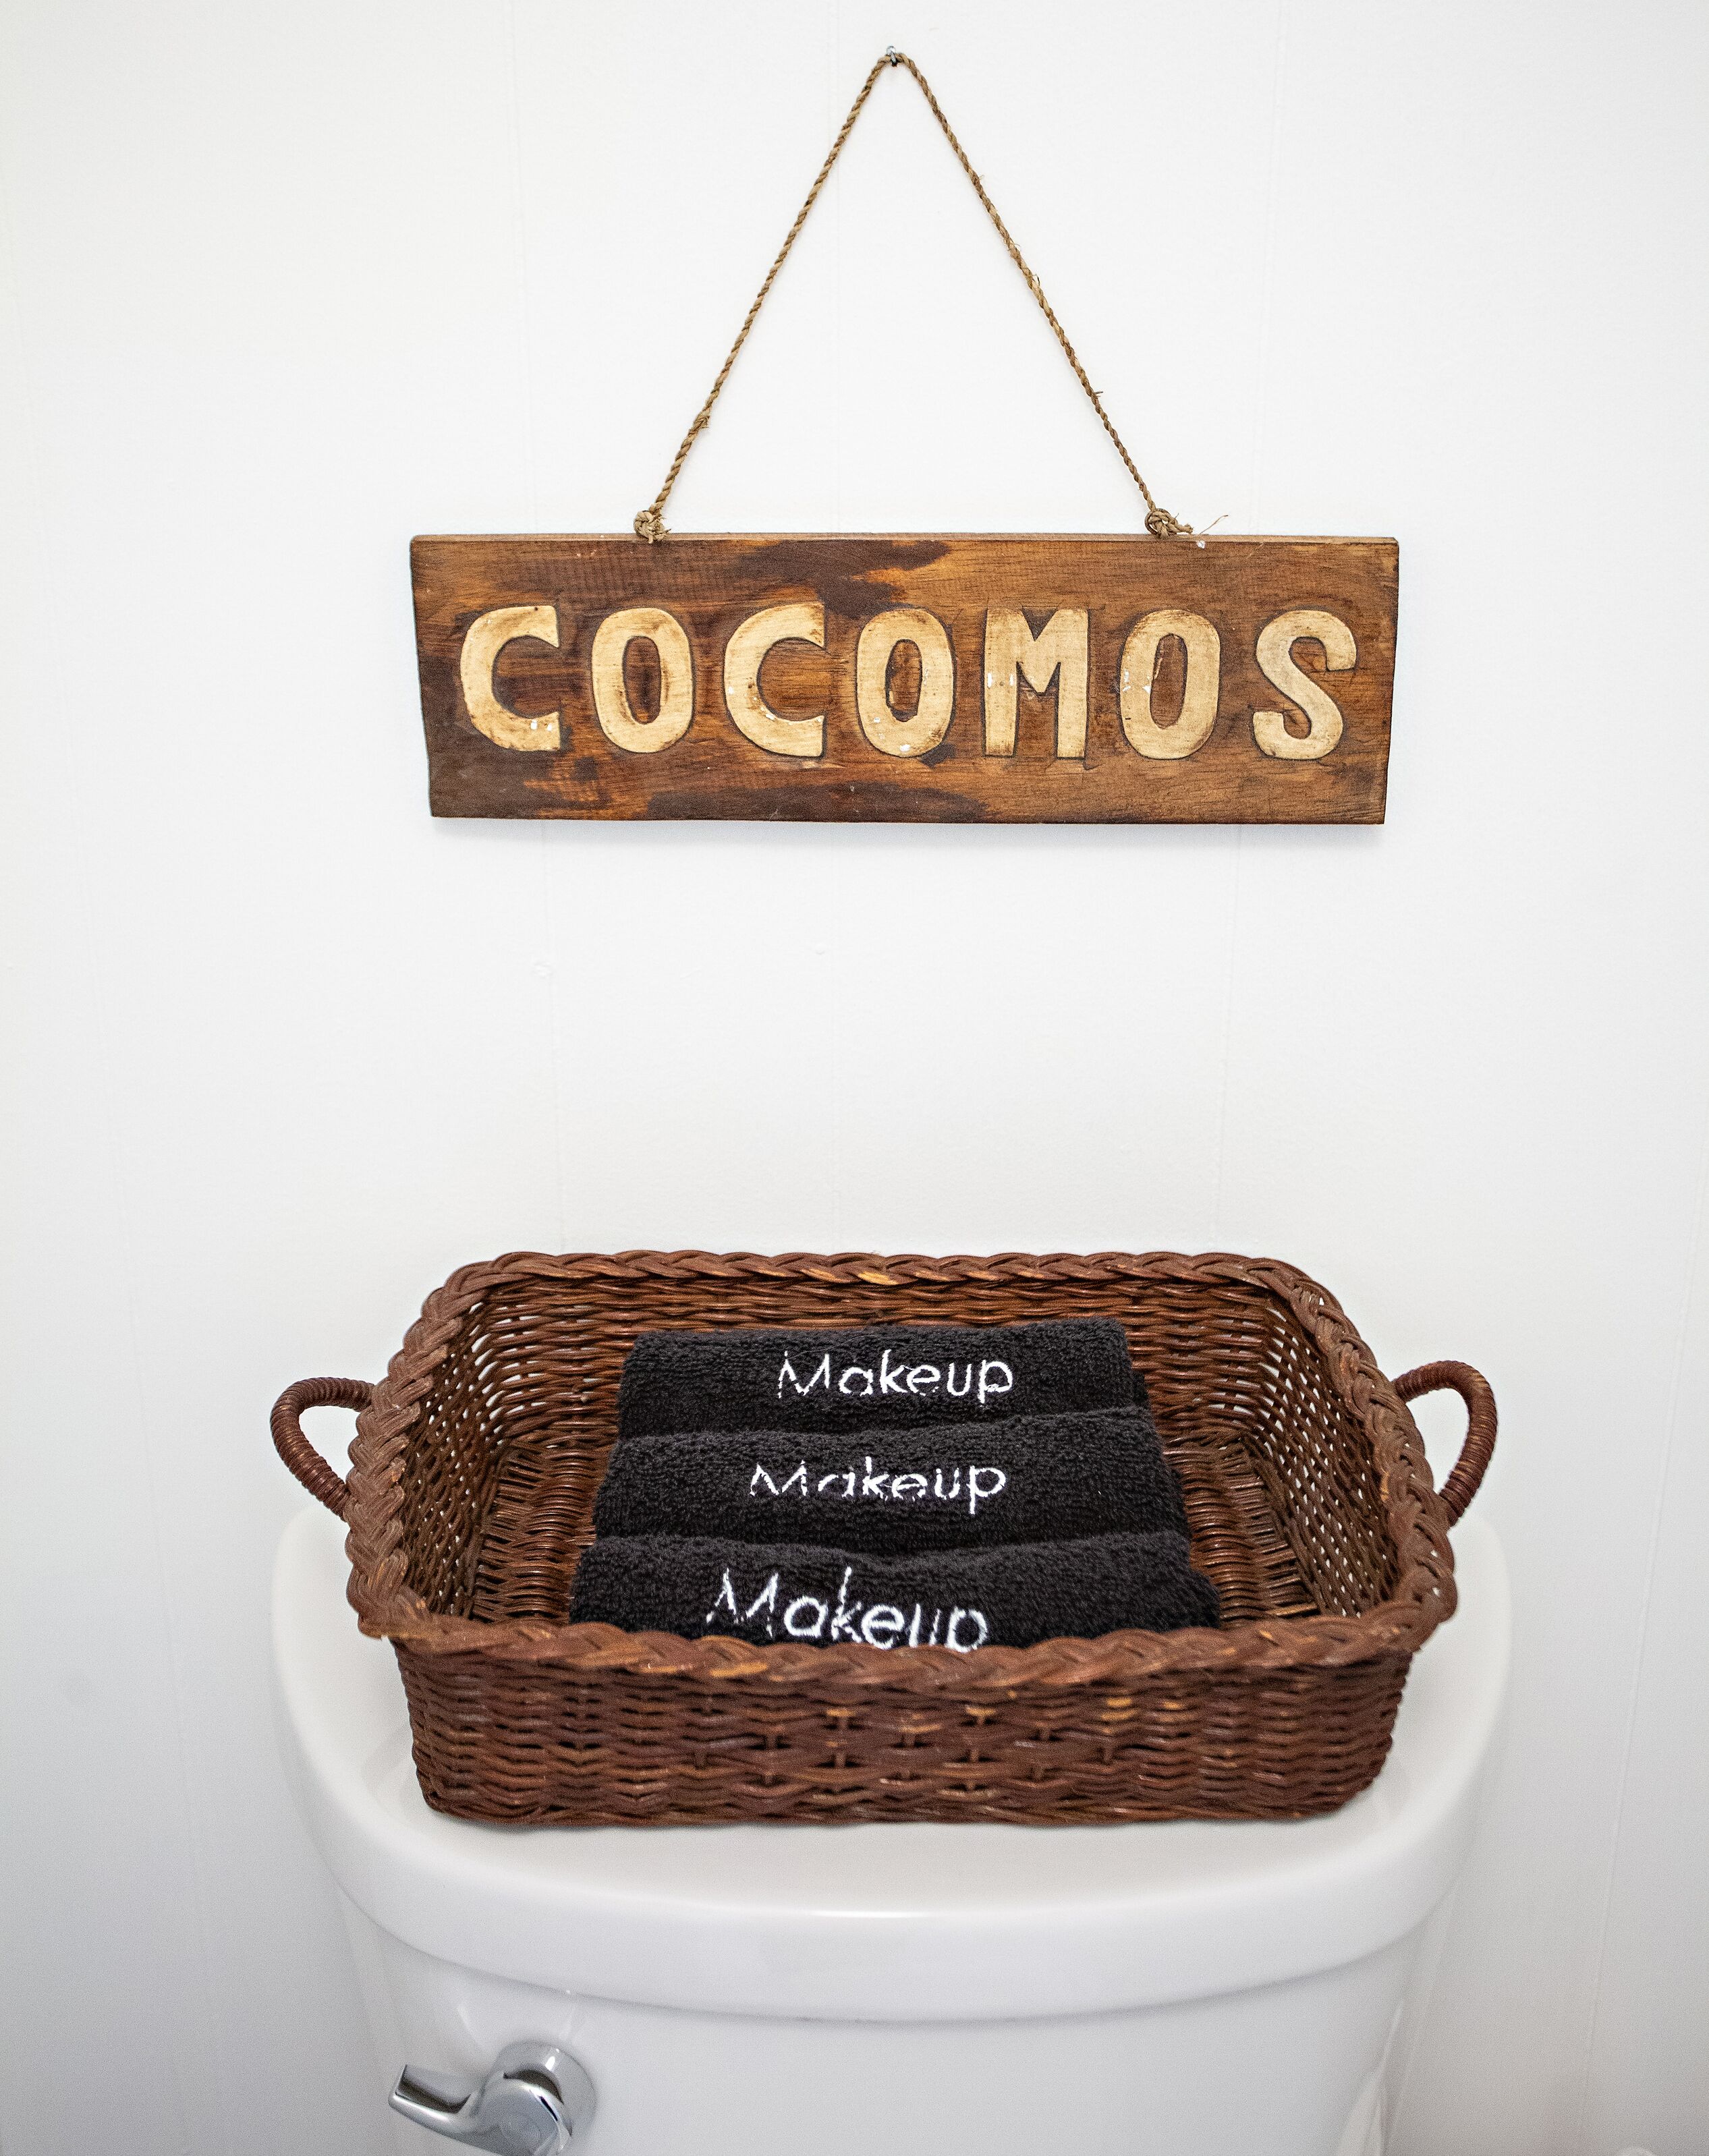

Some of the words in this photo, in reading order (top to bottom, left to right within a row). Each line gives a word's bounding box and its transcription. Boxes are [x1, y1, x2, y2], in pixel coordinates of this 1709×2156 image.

[460, 601, 1357, 759] COCOMOS
[777, 1349, 1013, 1406] Makeup
[750, 1456, 1007, 1515] Makeup
